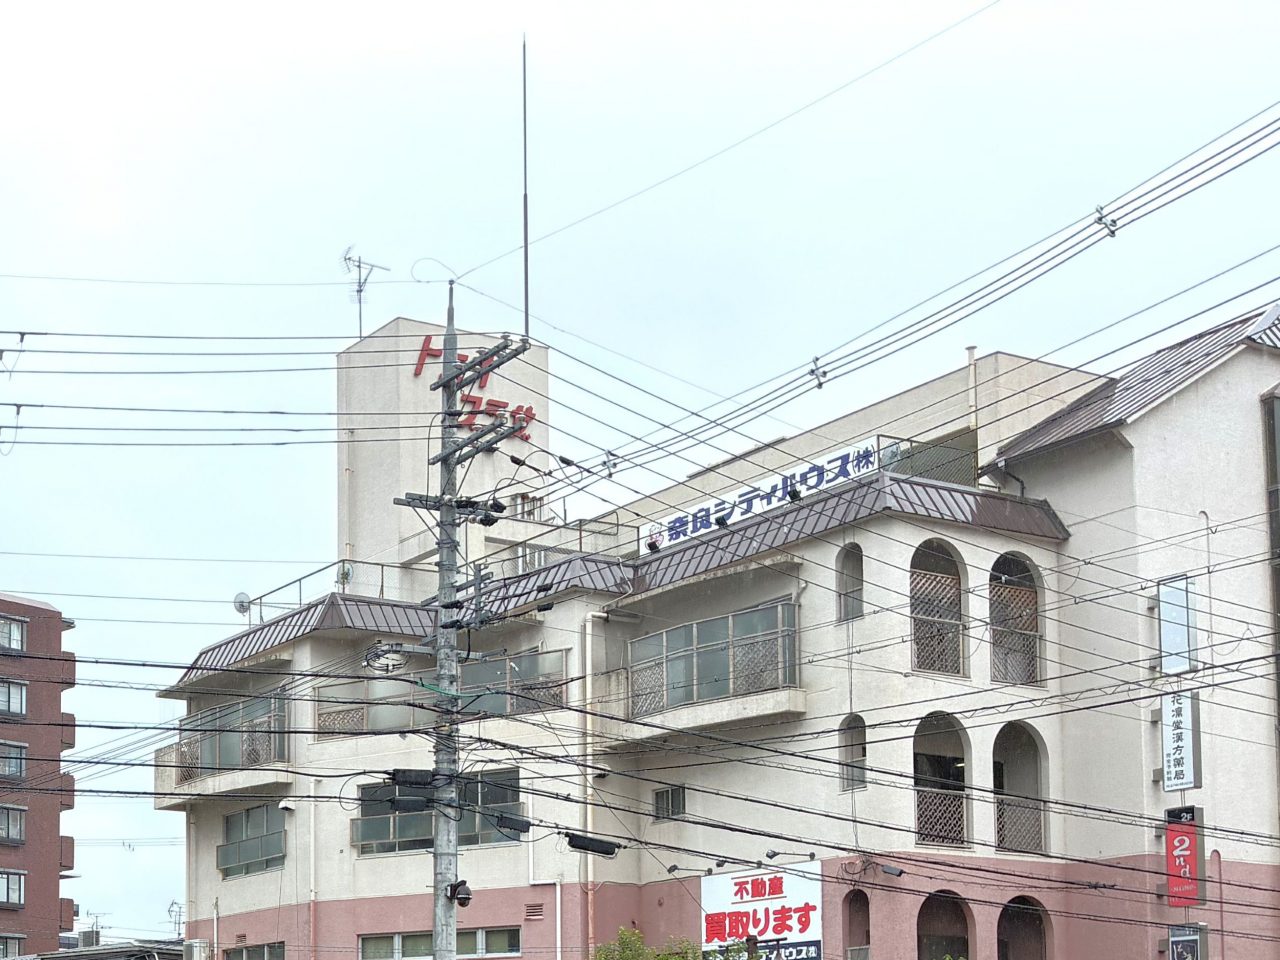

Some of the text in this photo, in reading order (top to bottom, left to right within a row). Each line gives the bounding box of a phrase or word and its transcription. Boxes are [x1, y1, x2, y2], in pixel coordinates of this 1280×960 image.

[1180, 812, 1193, 822] 2F
[734, 876, 784, 900] 不動産
[704, 902, 818, 944] 買取ります
